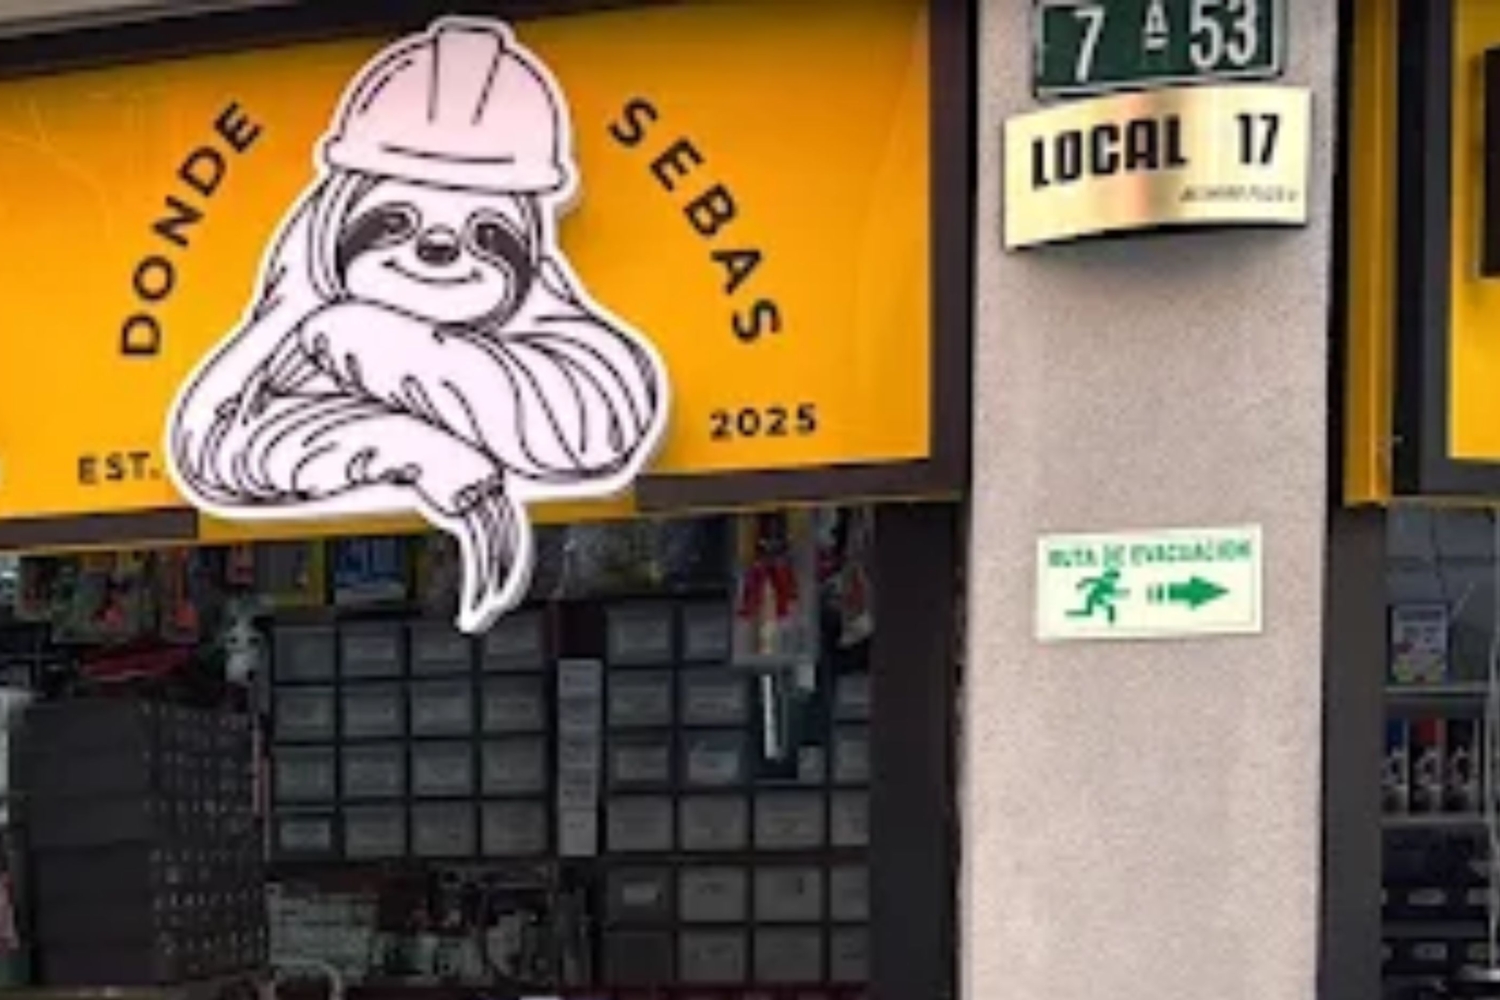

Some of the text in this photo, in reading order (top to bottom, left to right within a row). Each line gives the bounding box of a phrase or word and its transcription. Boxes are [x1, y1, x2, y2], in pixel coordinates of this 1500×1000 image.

[1073, 6, 1106, 83] 7
[1188, 0, 1260, 71] 53
[1030, 112, 1281, 188] LOCAL 17
[119, 96, 781, 358] DONDE SEBAS
[78, 402, 819, 485] EST. 2025
